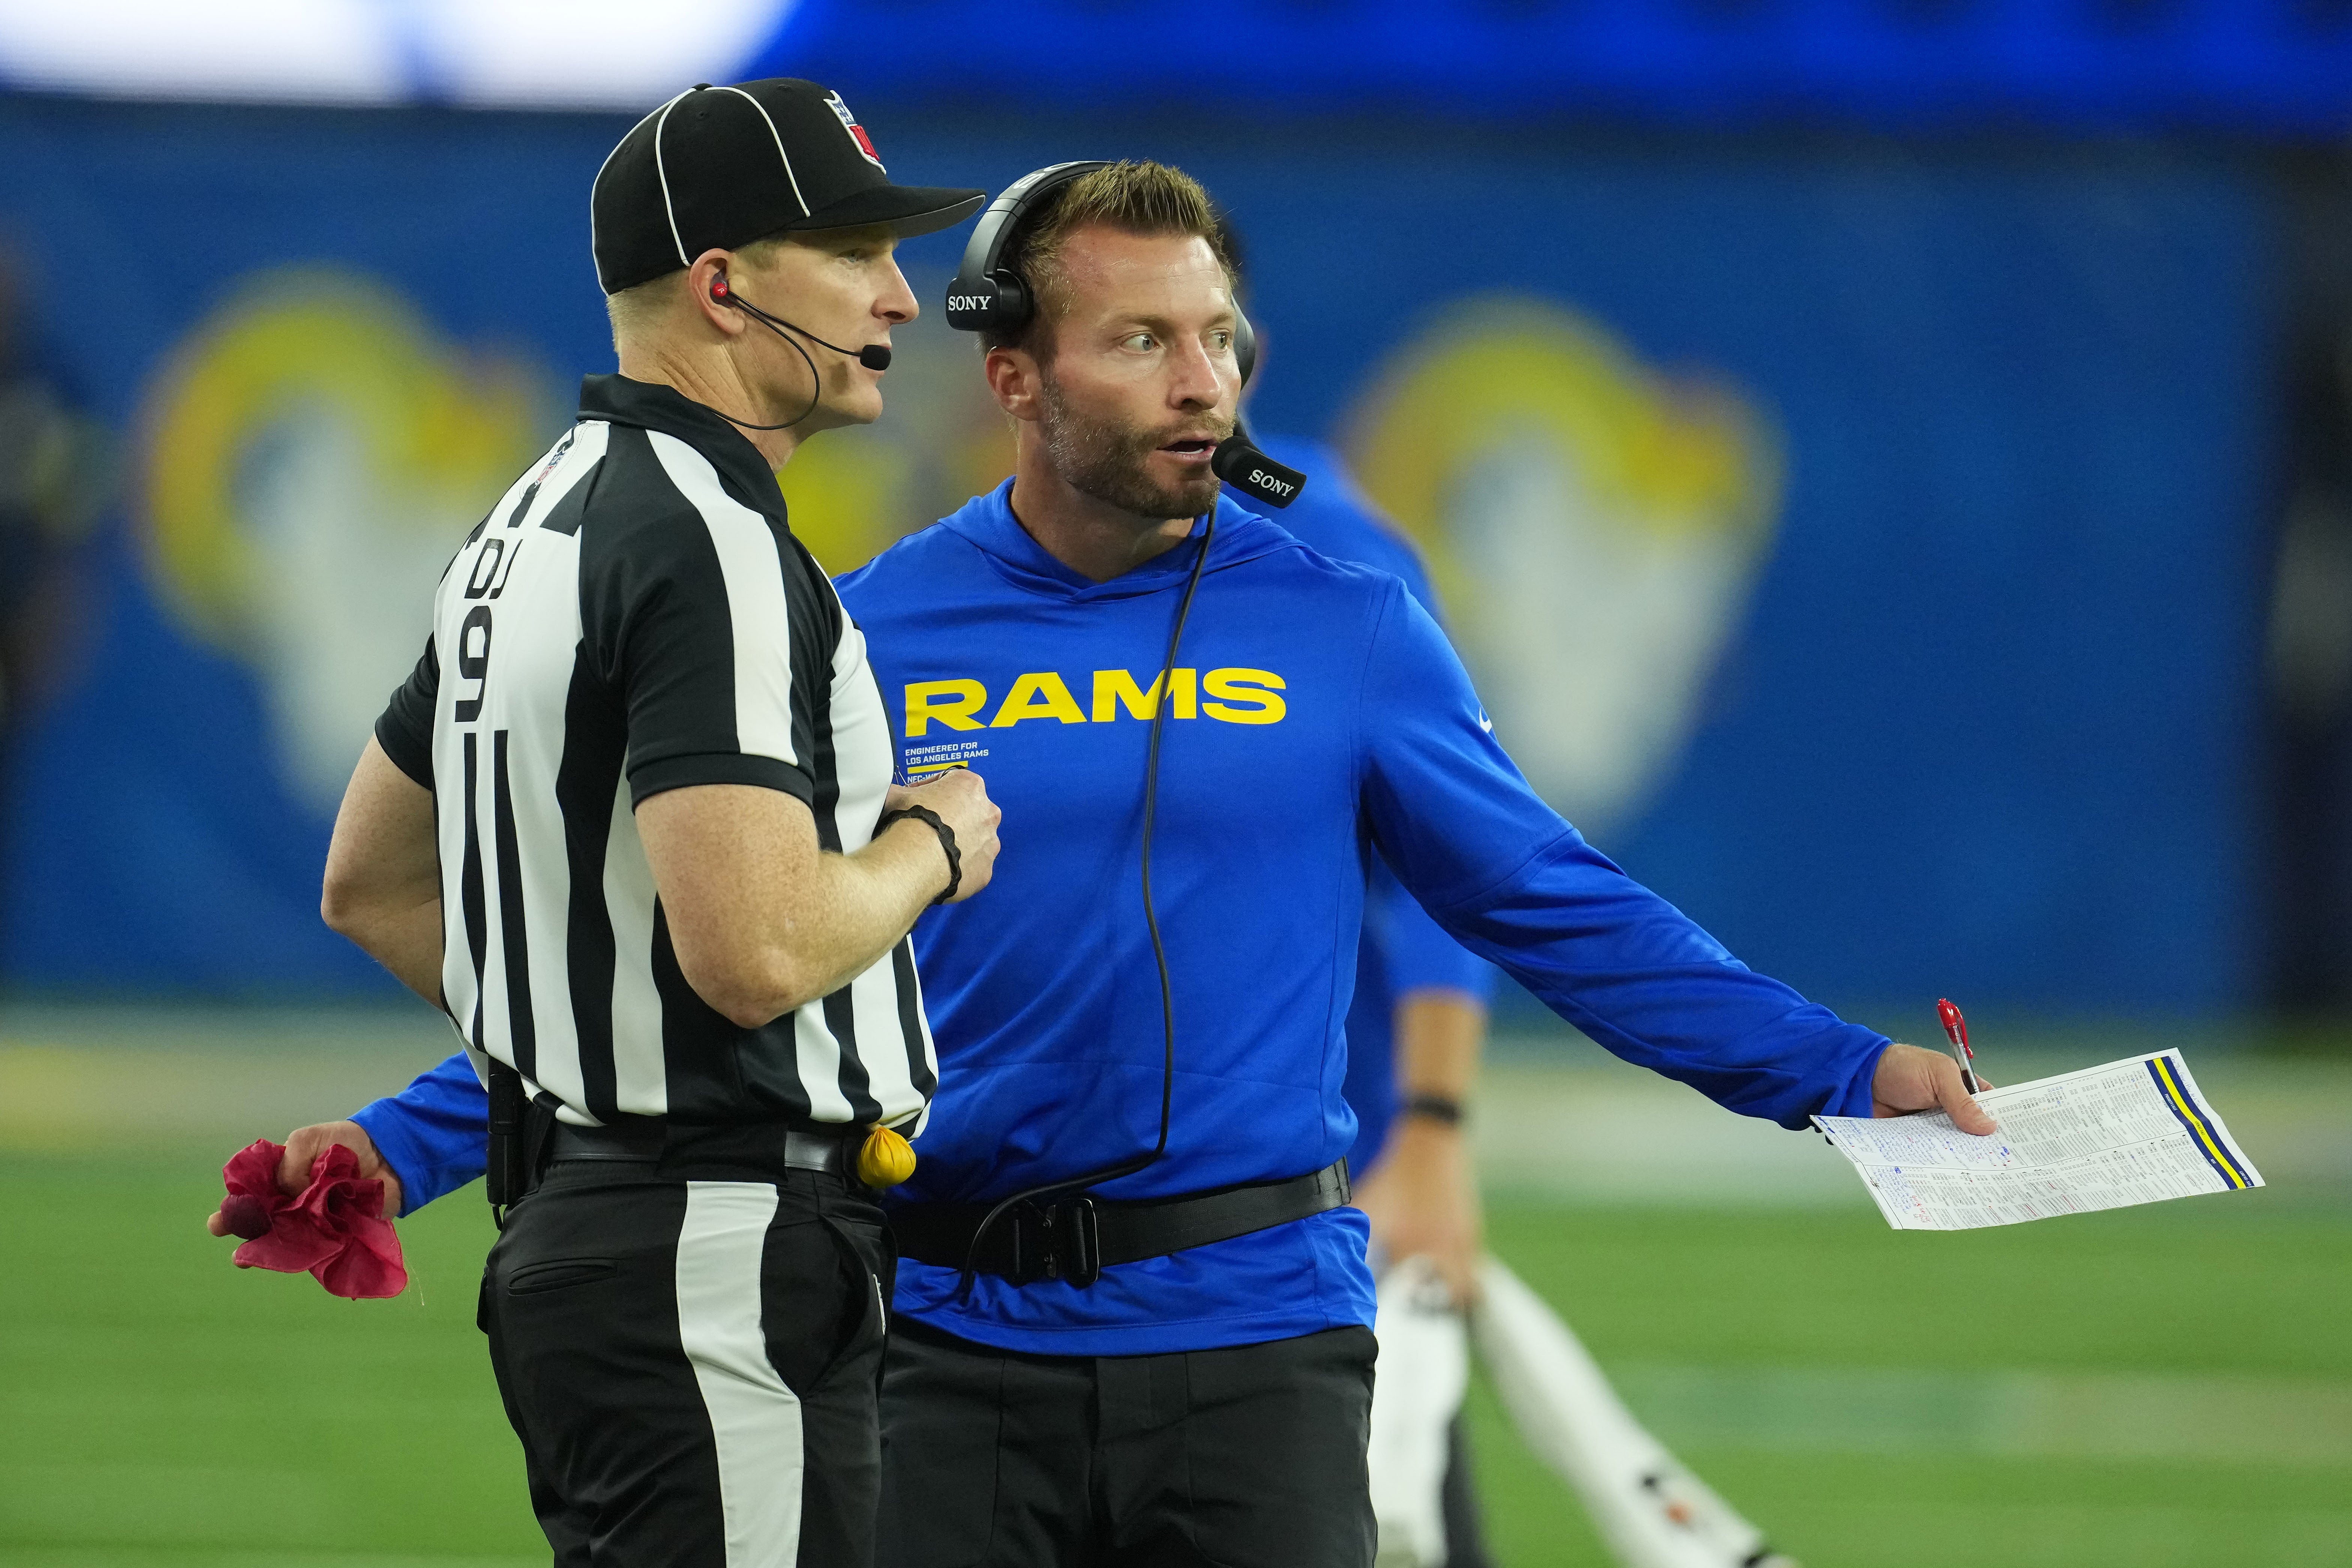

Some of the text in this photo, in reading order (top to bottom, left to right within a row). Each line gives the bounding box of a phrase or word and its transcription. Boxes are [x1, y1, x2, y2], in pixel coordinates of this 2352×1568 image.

[948, 295, 991, 311] SONY
[1248, 469, 1294, 497] SONY
[464, 538, 523, 600] DJ
[455, 606, 492, 722] 9
[905, 667, 1286, 737] RAMS
[905, 742, 978, 756] ENGINEERED FOR
[906, 749, 989, 765] LOS ANGELES RAMS
